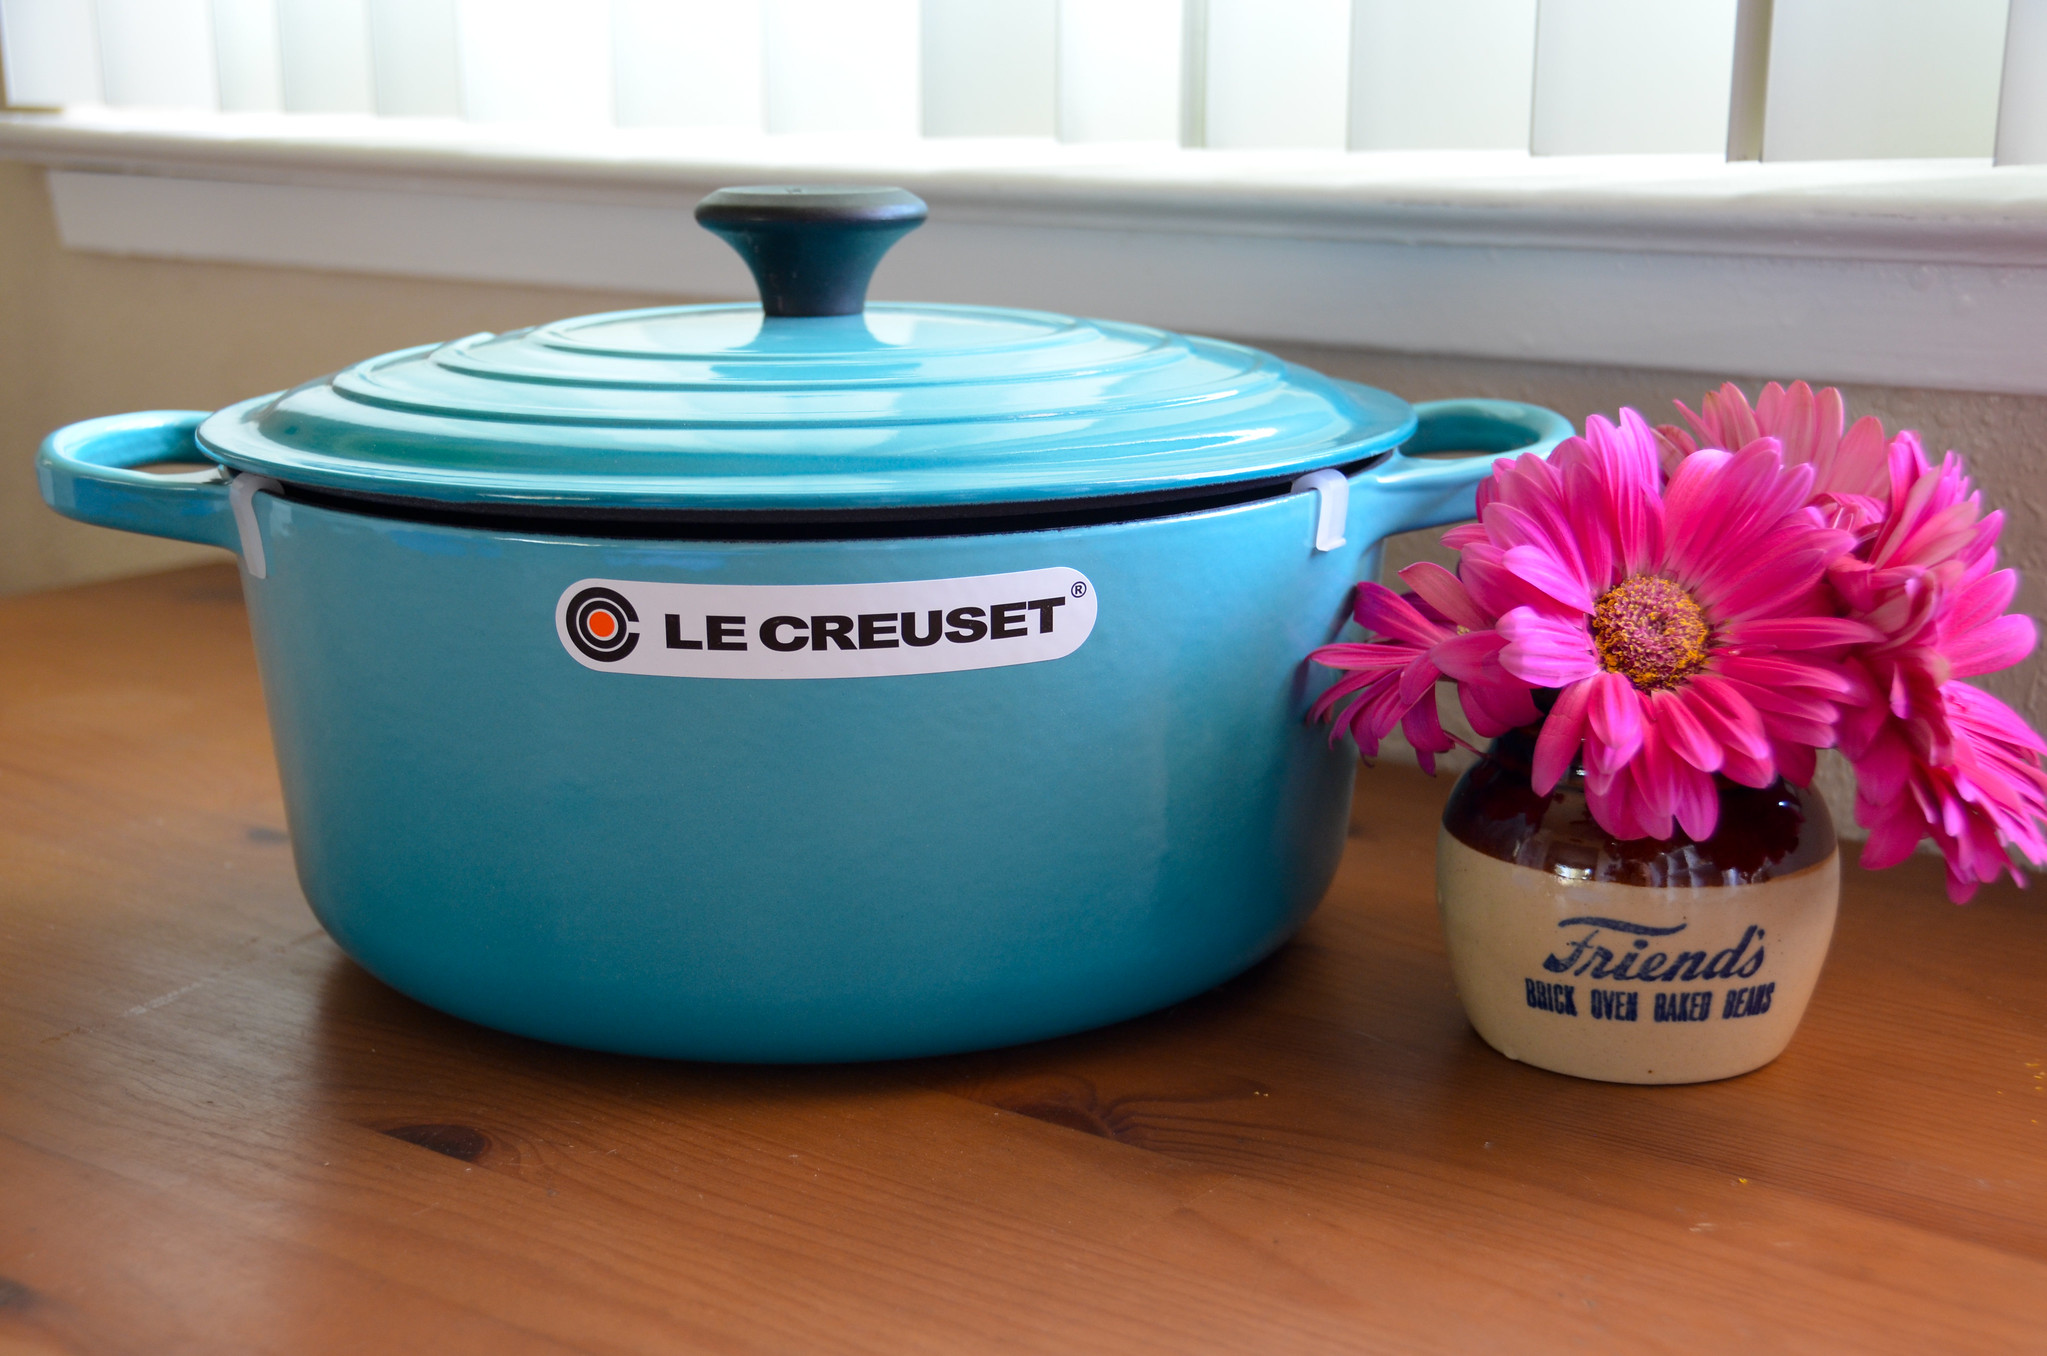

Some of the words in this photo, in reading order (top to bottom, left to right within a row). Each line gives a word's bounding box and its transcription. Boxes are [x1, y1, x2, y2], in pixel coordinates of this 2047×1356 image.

[665, 614, 748, 651] LE
[1525, 978, 1578, 1017] BRICK
[1590, 989, 1638, 1022] OVEN
[1653, 991, 1713, 1023] BAKED
[1722, 982, 1776, 1020] BEANS
